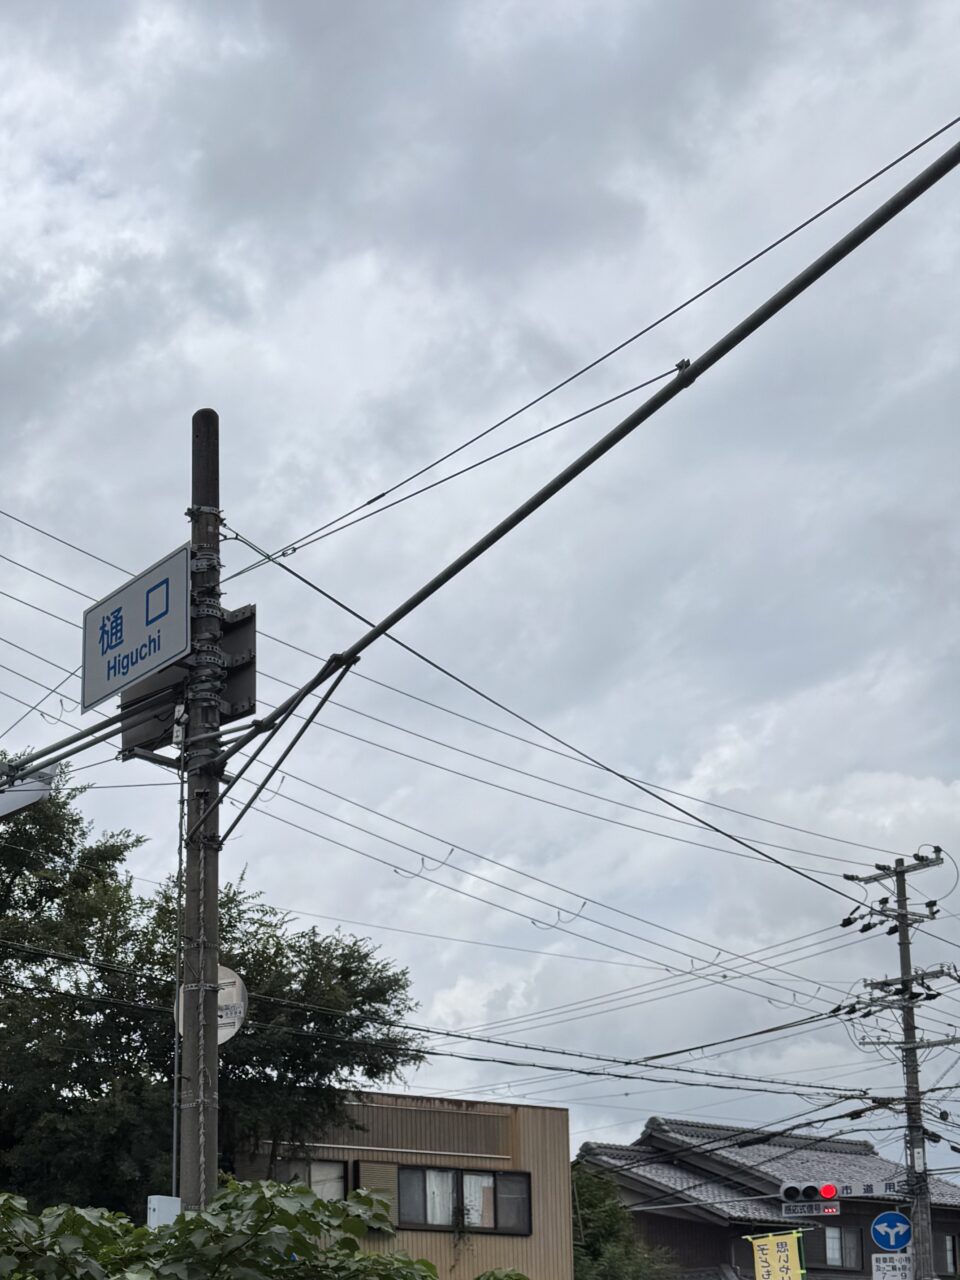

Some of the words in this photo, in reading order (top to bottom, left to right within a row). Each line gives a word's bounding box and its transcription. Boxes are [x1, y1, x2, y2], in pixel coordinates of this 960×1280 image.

[98, 577, 170, 656] 樋口
[106, 629, 162, 681] Higuchi
[841, 1182, 896, 1195] 市道用
